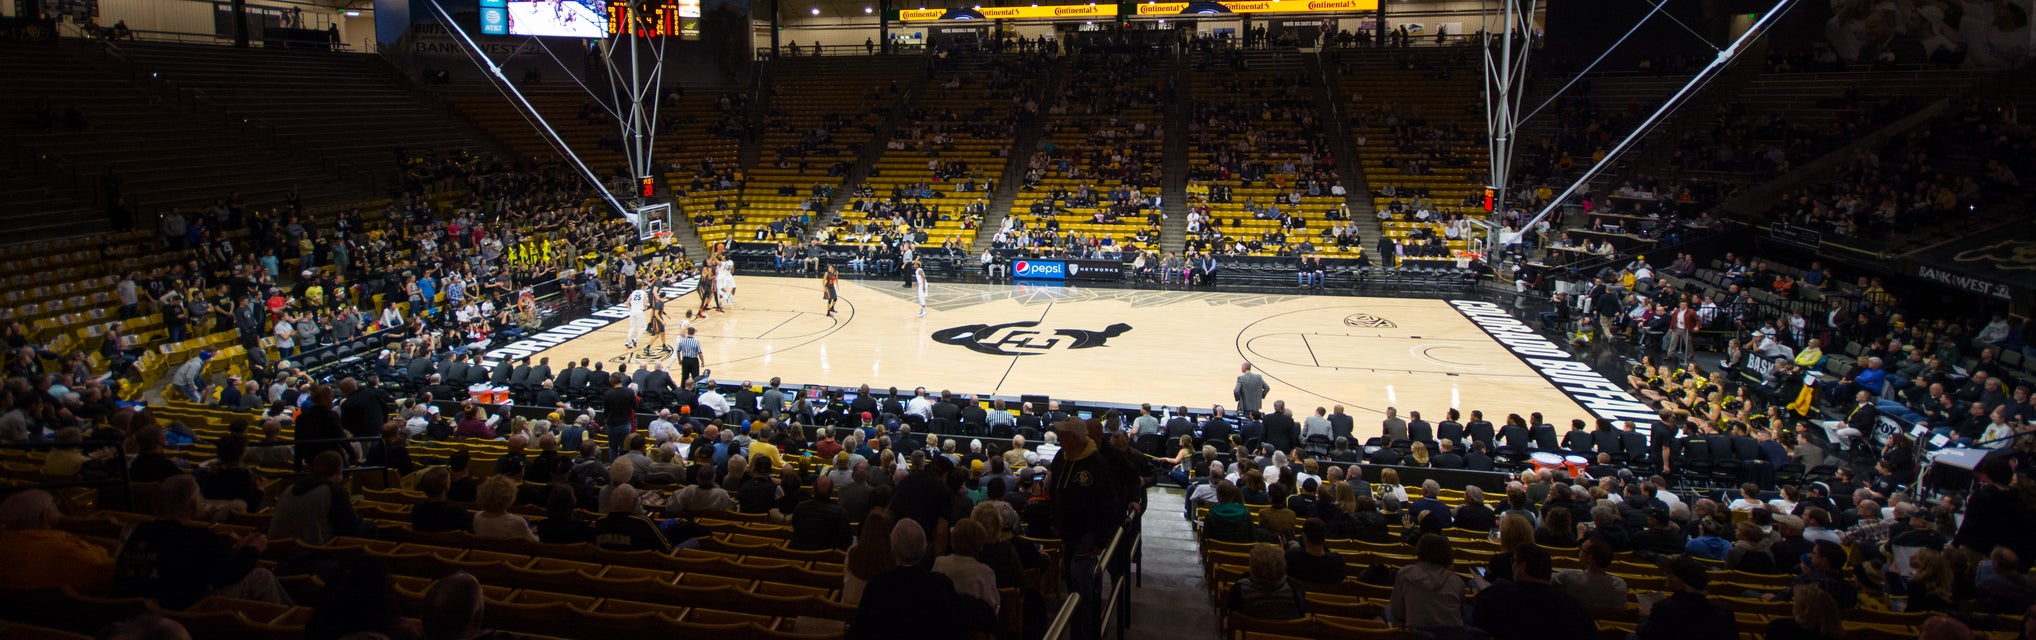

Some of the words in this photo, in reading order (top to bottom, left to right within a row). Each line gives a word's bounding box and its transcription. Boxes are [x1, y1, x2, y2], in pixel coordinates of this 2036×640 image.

[1140, 4, 1180, 14] Continental
[1308, 1, 1350, 10] Continental
[903, 11, 938, 19] Continental
[1054, 7, 1092, 16] Continental
[416, 42, 460, 53] BANK
[1031, 264, 1062, 275] pepsi
[1918, 265, 1953, 284] BANK
[1957, 275, 1993, 295] WEST
[1449, 300, 1572, 359] COLORADO
